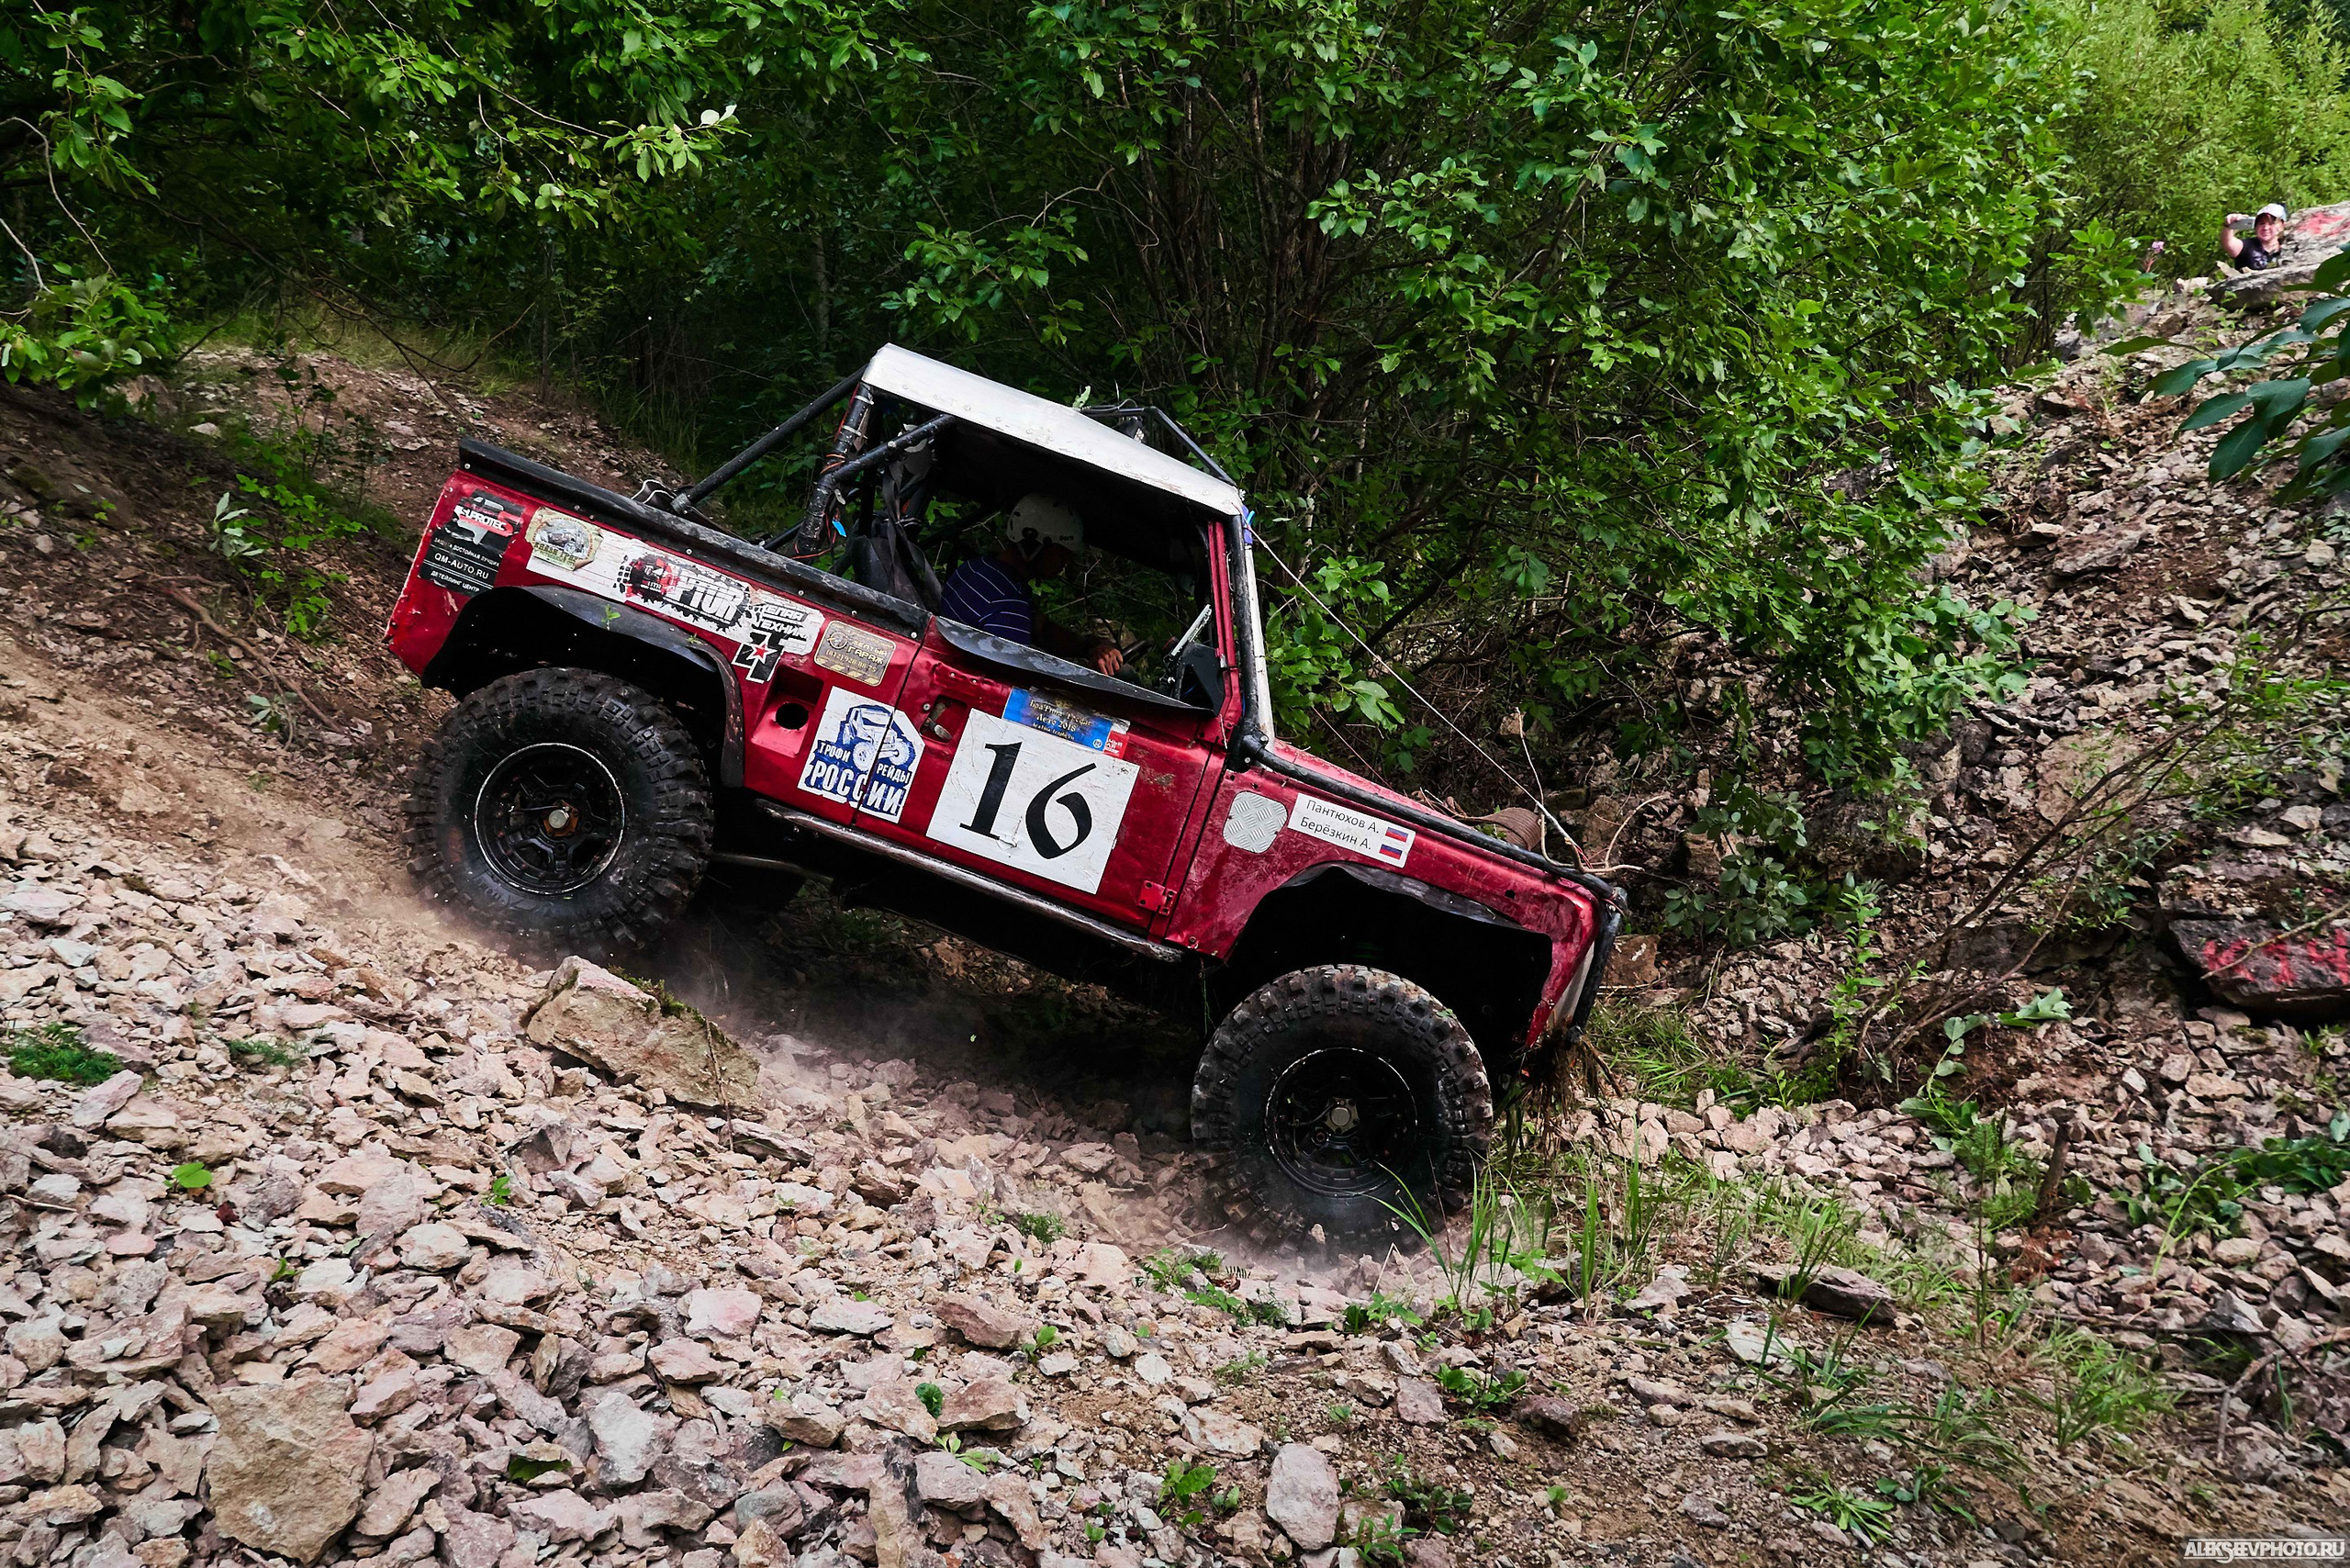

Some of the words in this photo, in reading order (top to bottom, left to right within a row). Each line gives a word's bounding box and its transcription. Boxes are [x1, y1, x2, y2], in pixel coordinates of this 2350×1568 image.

[459, 506, 507, 531] SUPROTEC
[434, 553, 489, 579] QM-AUTO.RU
[846, 644, 885, 665] ГАРАЖ
[1057, 719, 1077, 733] 2018
[817, 741, 851, 762] ТРОФИ
[876, 761, 911, 785] РЕЙДЫ
[809, 759, 903, 814] РОССИИ
[959, 740, 1097, 860] 16
[1300, 816, 1358, 846] Берёзкин
[1360, 837, 1371, 850] А.
[1306, 800, 1366, 828] Пантюхов
[1367, 821, 1380, 834] А.
